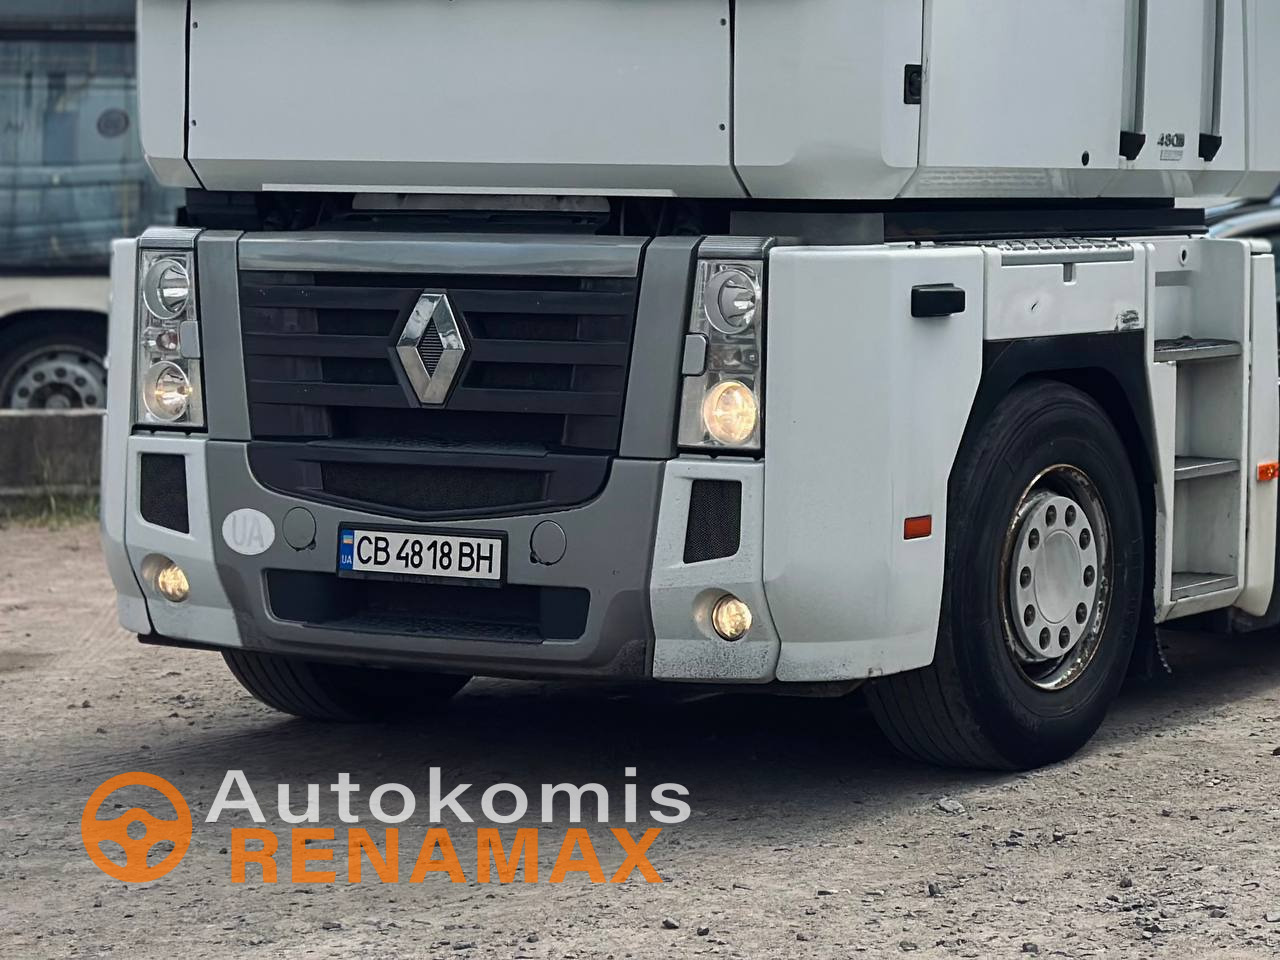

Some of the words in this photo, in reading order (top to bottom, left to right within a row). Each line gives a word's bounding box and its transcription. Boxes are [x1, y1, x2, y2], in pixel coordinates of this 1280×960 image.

[231, 514, 265, 548] UA
[341, 554, 353, 565] UA
[356, 536, 390, 566] CB
[396, 539, 453, 571] 4818
[458, 541, 494, 574] BH
